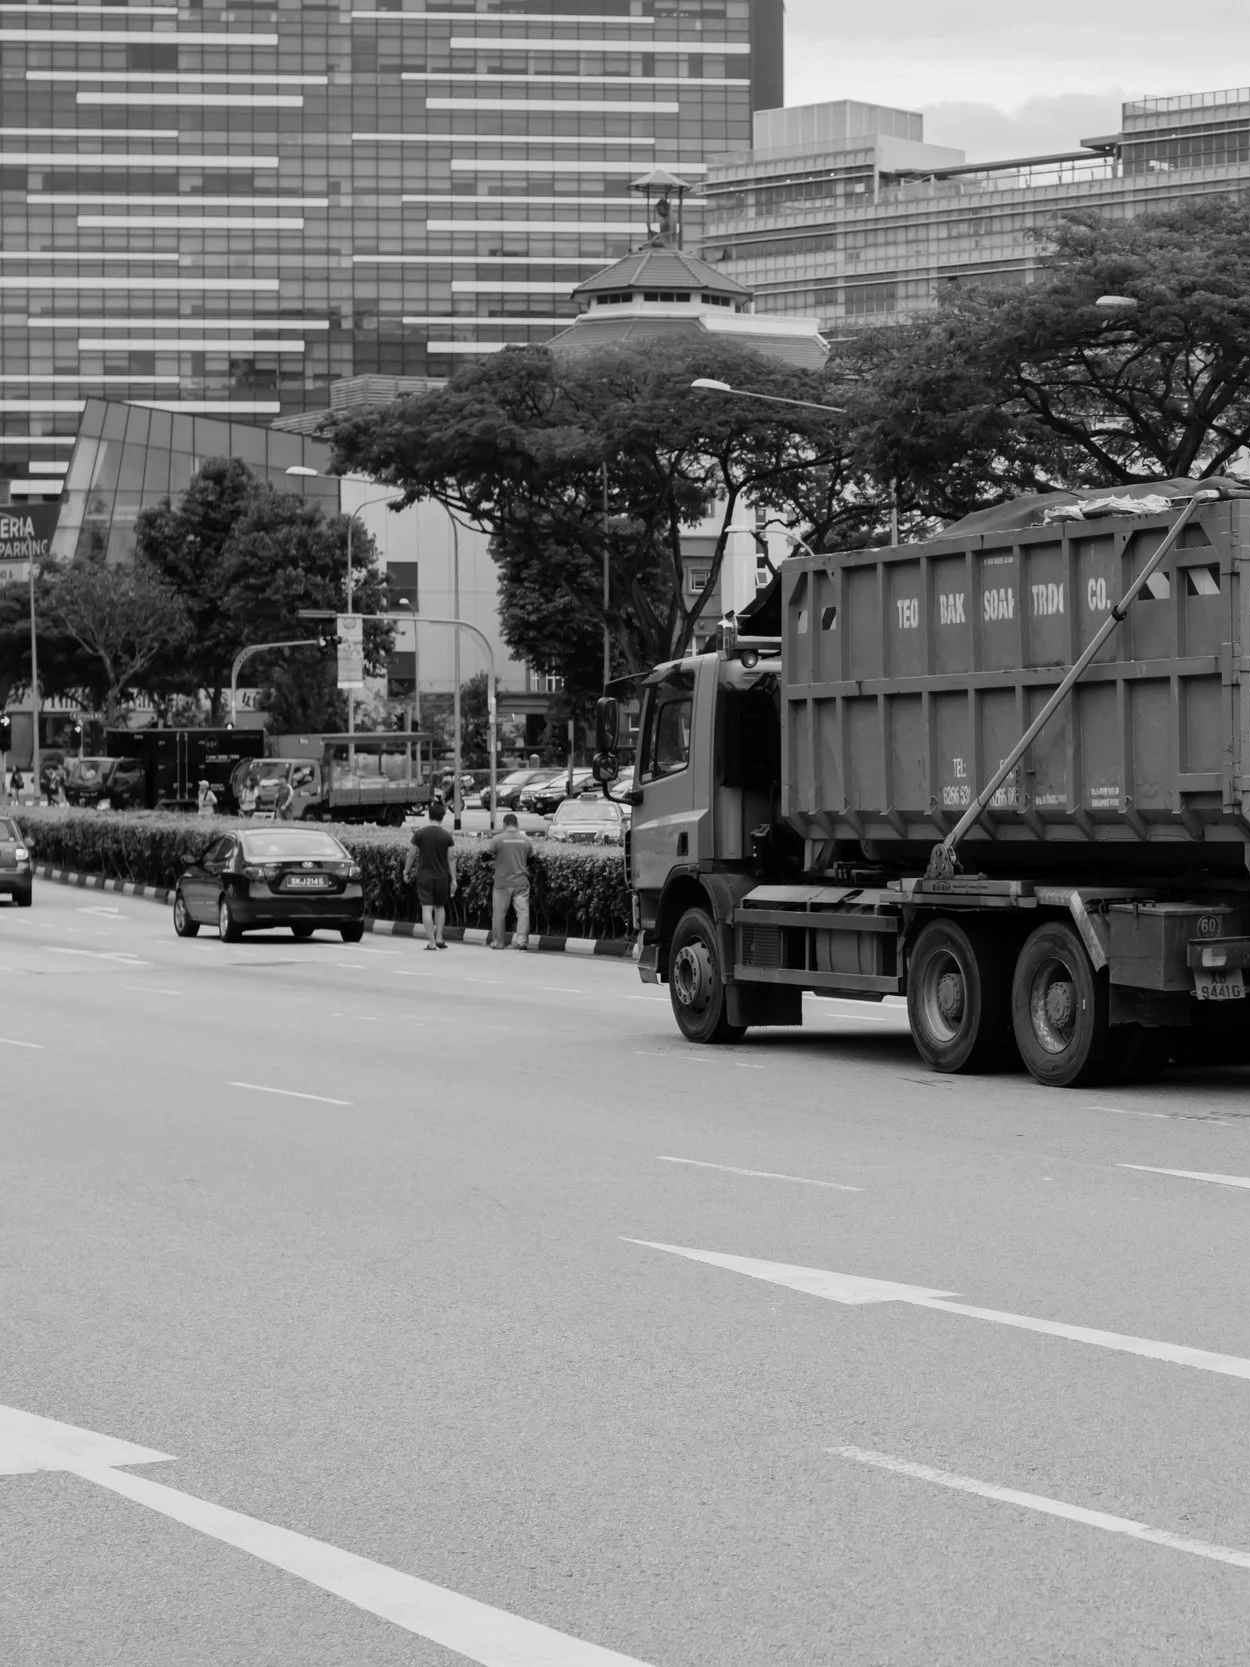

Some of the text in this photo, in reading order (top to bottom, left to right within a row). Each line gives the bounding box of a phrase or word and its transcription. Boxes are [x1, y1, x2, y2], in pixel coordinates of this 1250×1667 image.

[897, 598, 918, 629] TEO
[940, 593, 966, 624] BAK
[1088, 577, 1111, 611] CO.
[952, 758, 967, 778] TEL:
[1201, 918, 1217, 933] 60
[1201, 985, 1241, 999] 9441G
